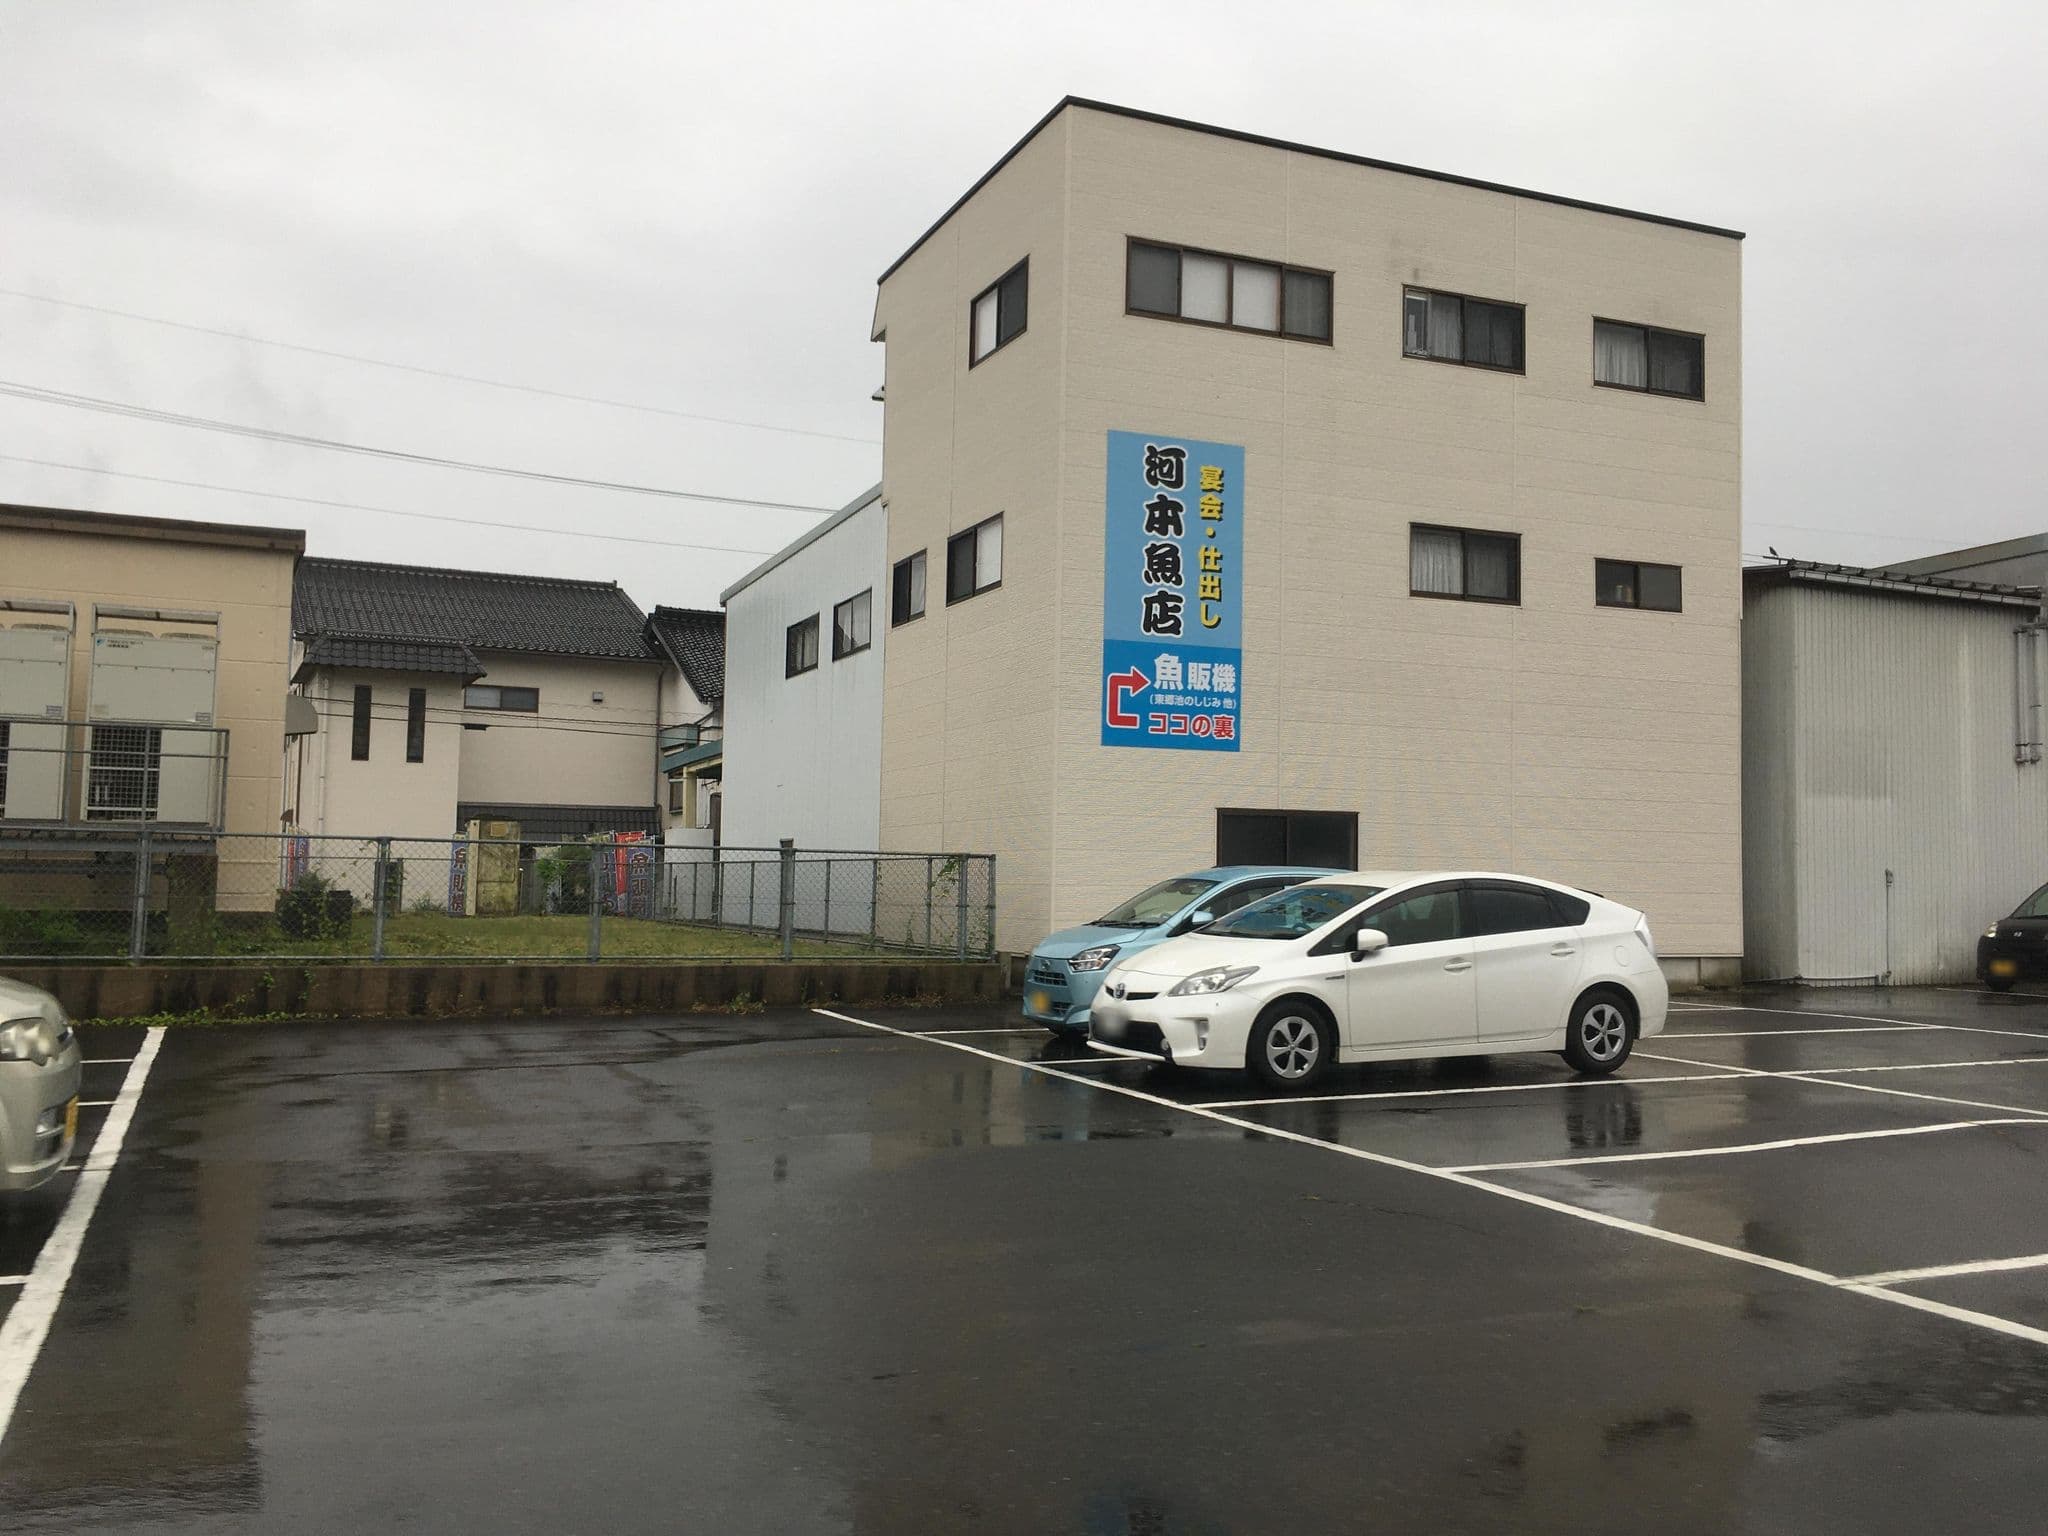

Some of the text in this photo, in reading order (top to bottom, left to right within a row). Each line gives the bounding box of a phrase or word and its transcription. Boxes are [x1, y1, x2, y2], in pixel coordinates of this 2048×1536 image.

[1142, 443, 1188, 637] 河本魚店
[1198, 464, 1224, 629] 宴会・仕出し
[1154, 653, 1236, 693] 魚販機
[1148, 712, 1235, 740] ココの裏
